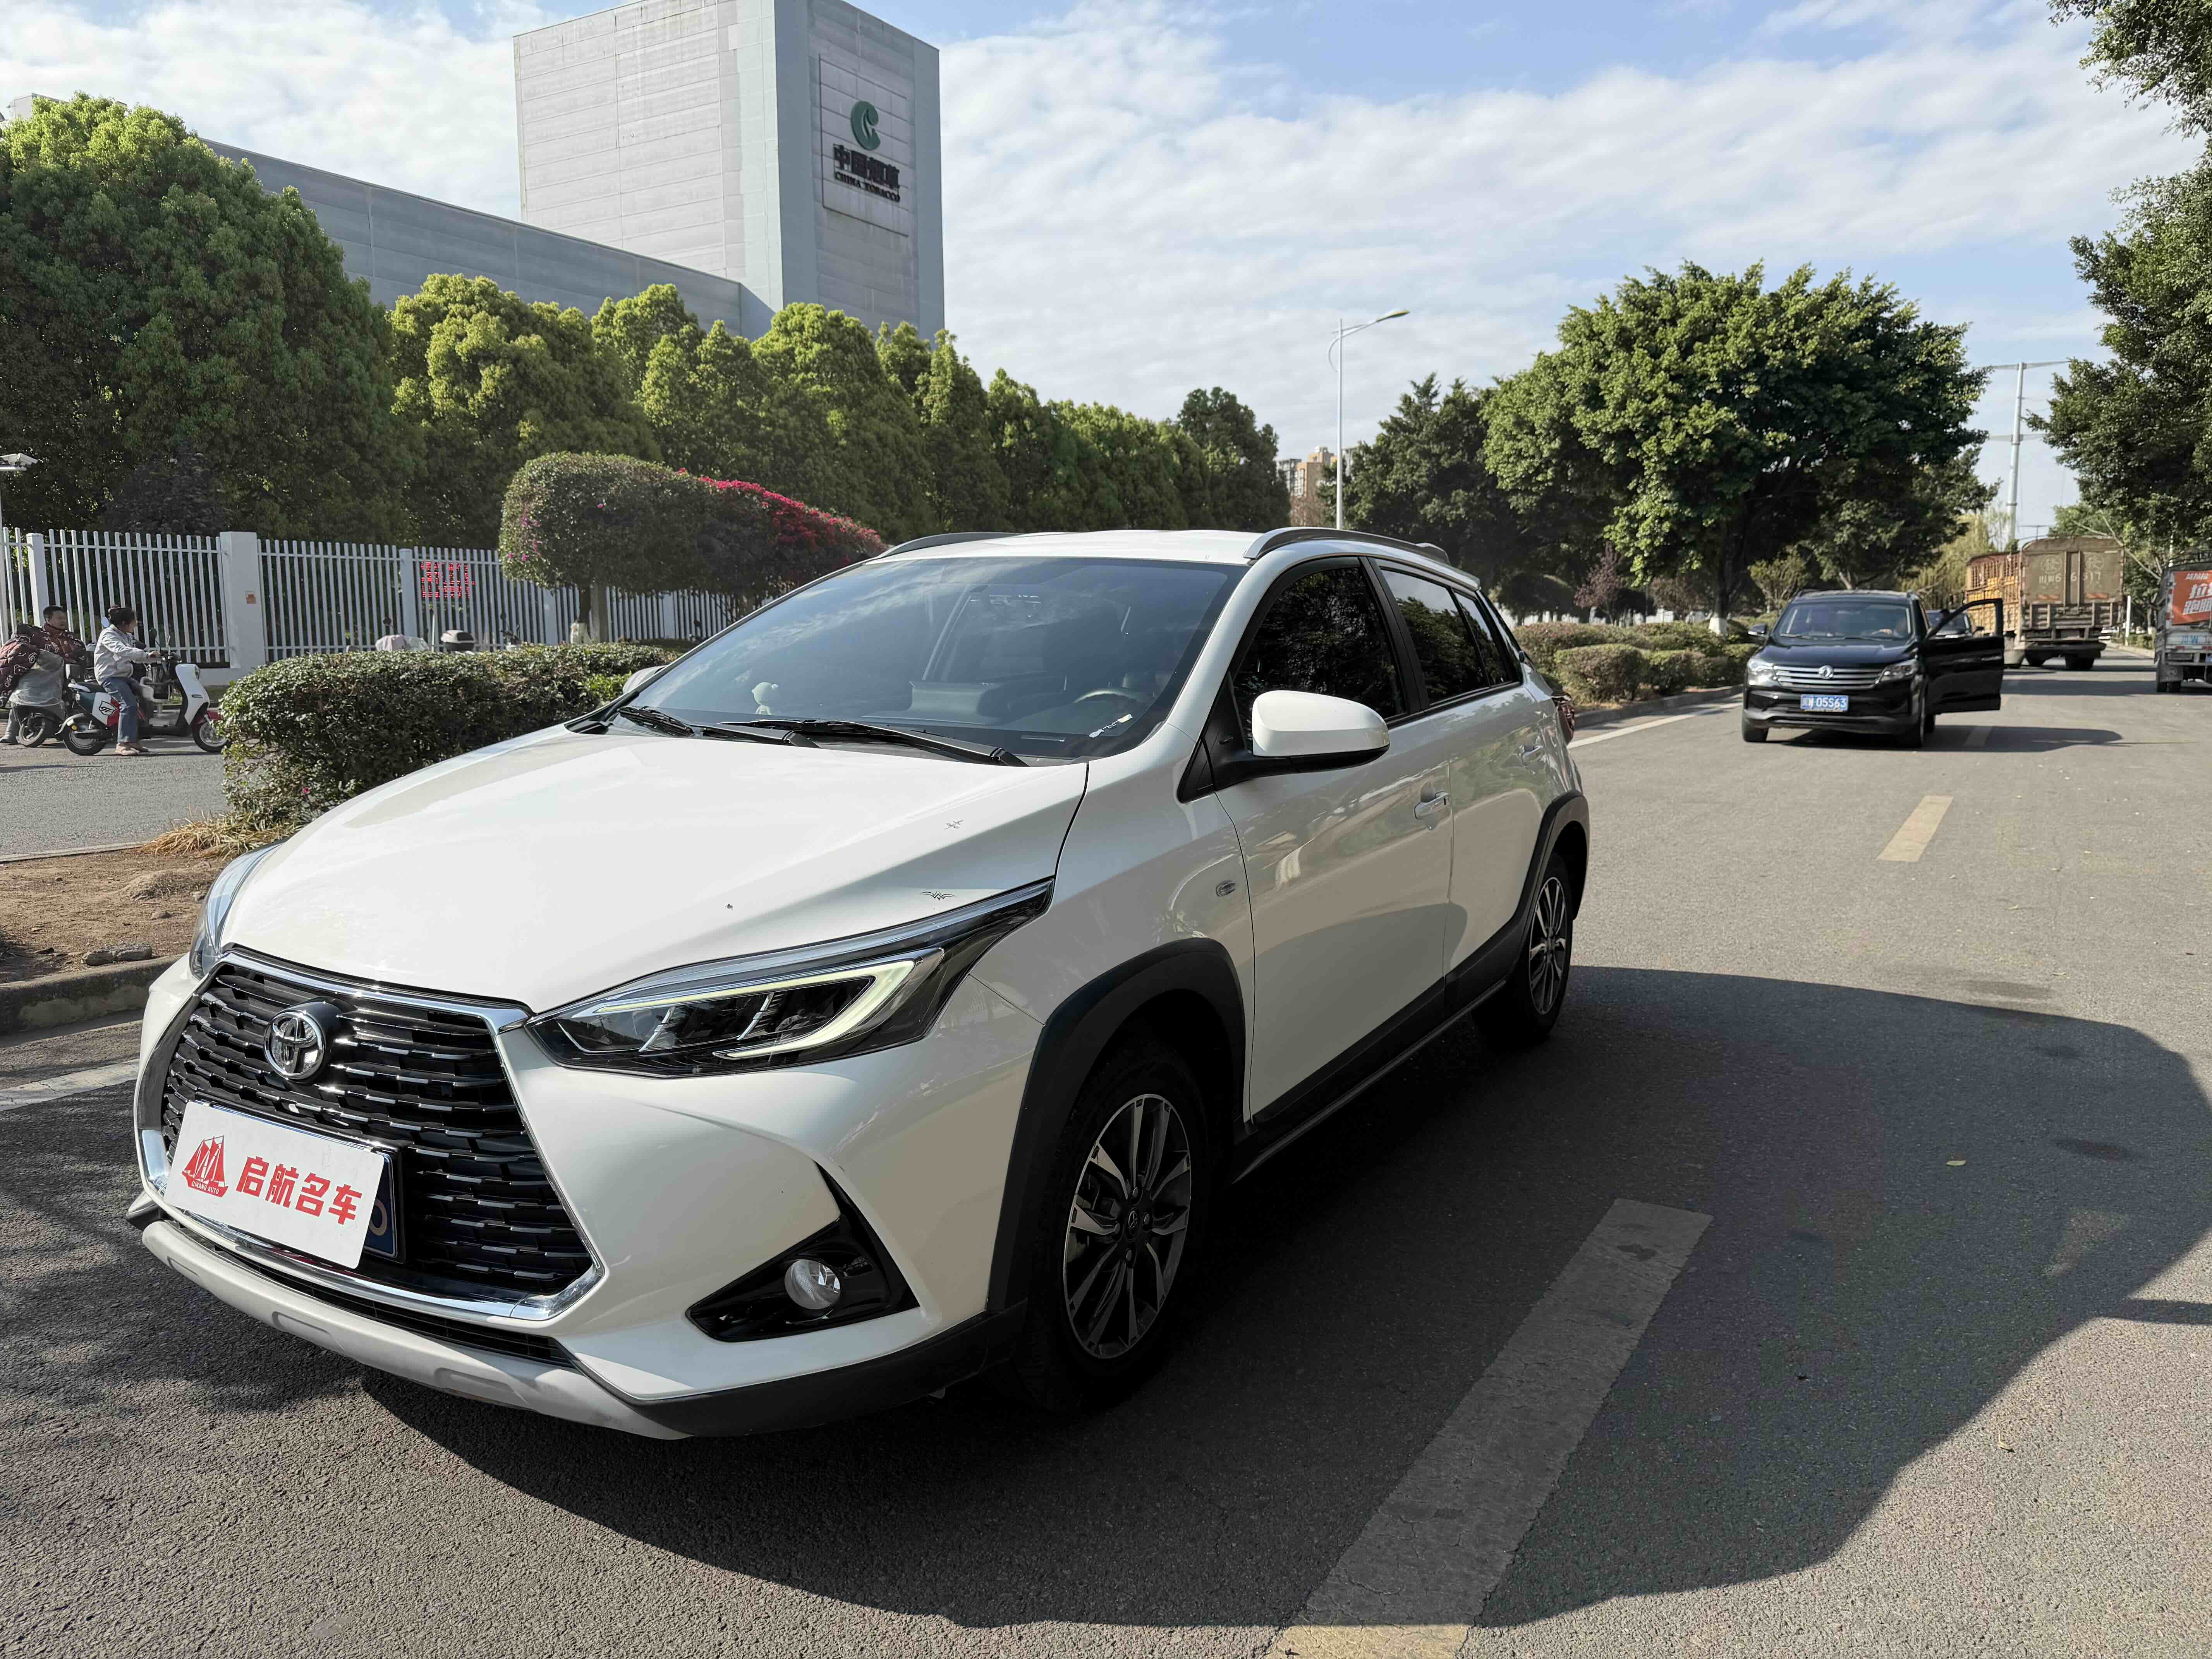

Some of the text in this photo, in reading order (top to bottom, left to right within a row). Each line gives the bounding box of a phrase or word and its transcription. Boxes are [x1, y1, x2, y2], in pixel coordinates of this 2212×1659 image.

[835, 172, 900, 203] CHINA TOBACCO
[208, 1186, 219, 1195] AUTO
[235, 1156, 362, 1225] 启航名车
